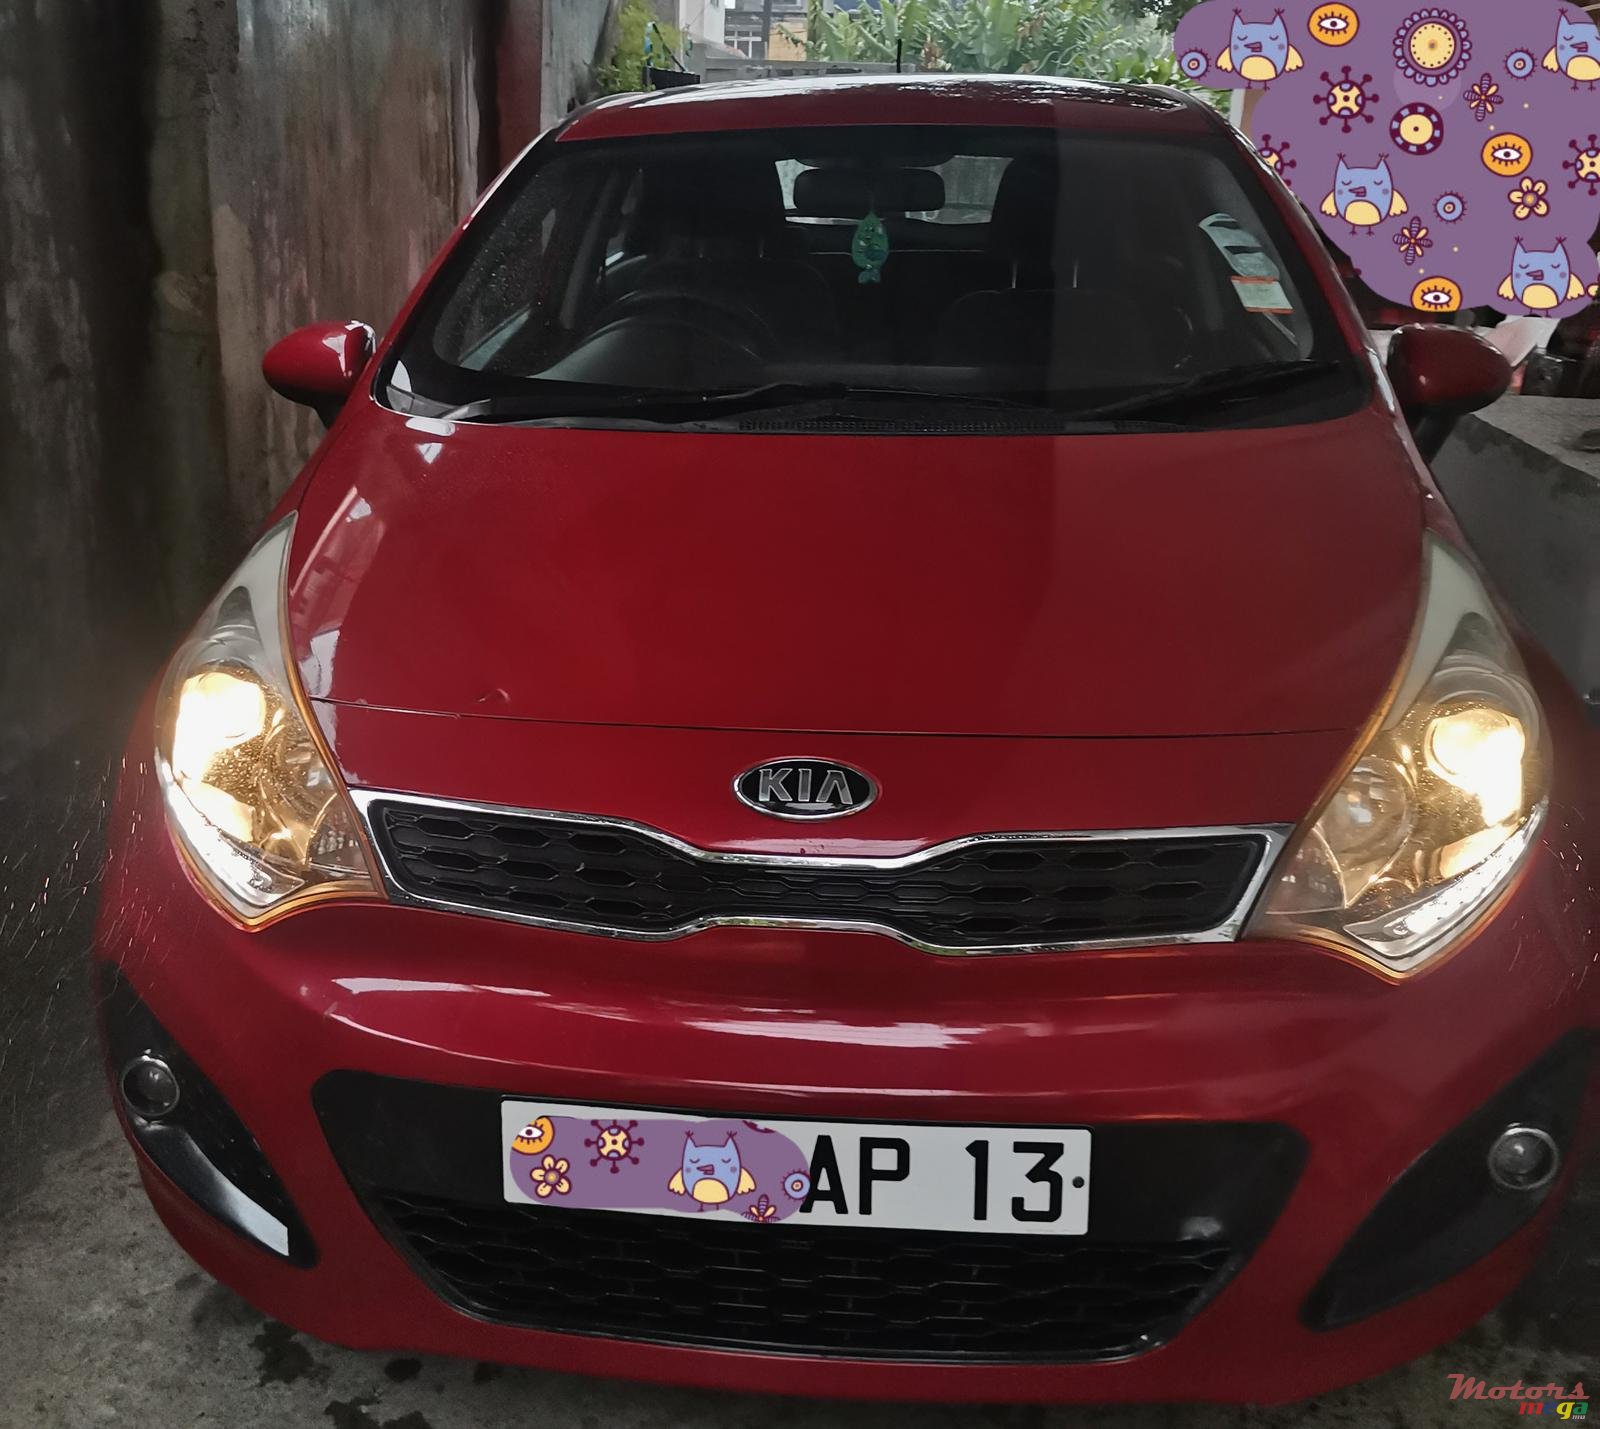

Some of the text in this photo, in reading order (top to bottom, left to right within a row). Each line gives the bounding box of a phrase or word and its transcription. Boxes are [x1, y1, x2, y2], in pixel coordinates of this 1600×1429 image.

[758, 768, 853, 805] KIA
[799, 1134, 1065, 1223] AP 13
